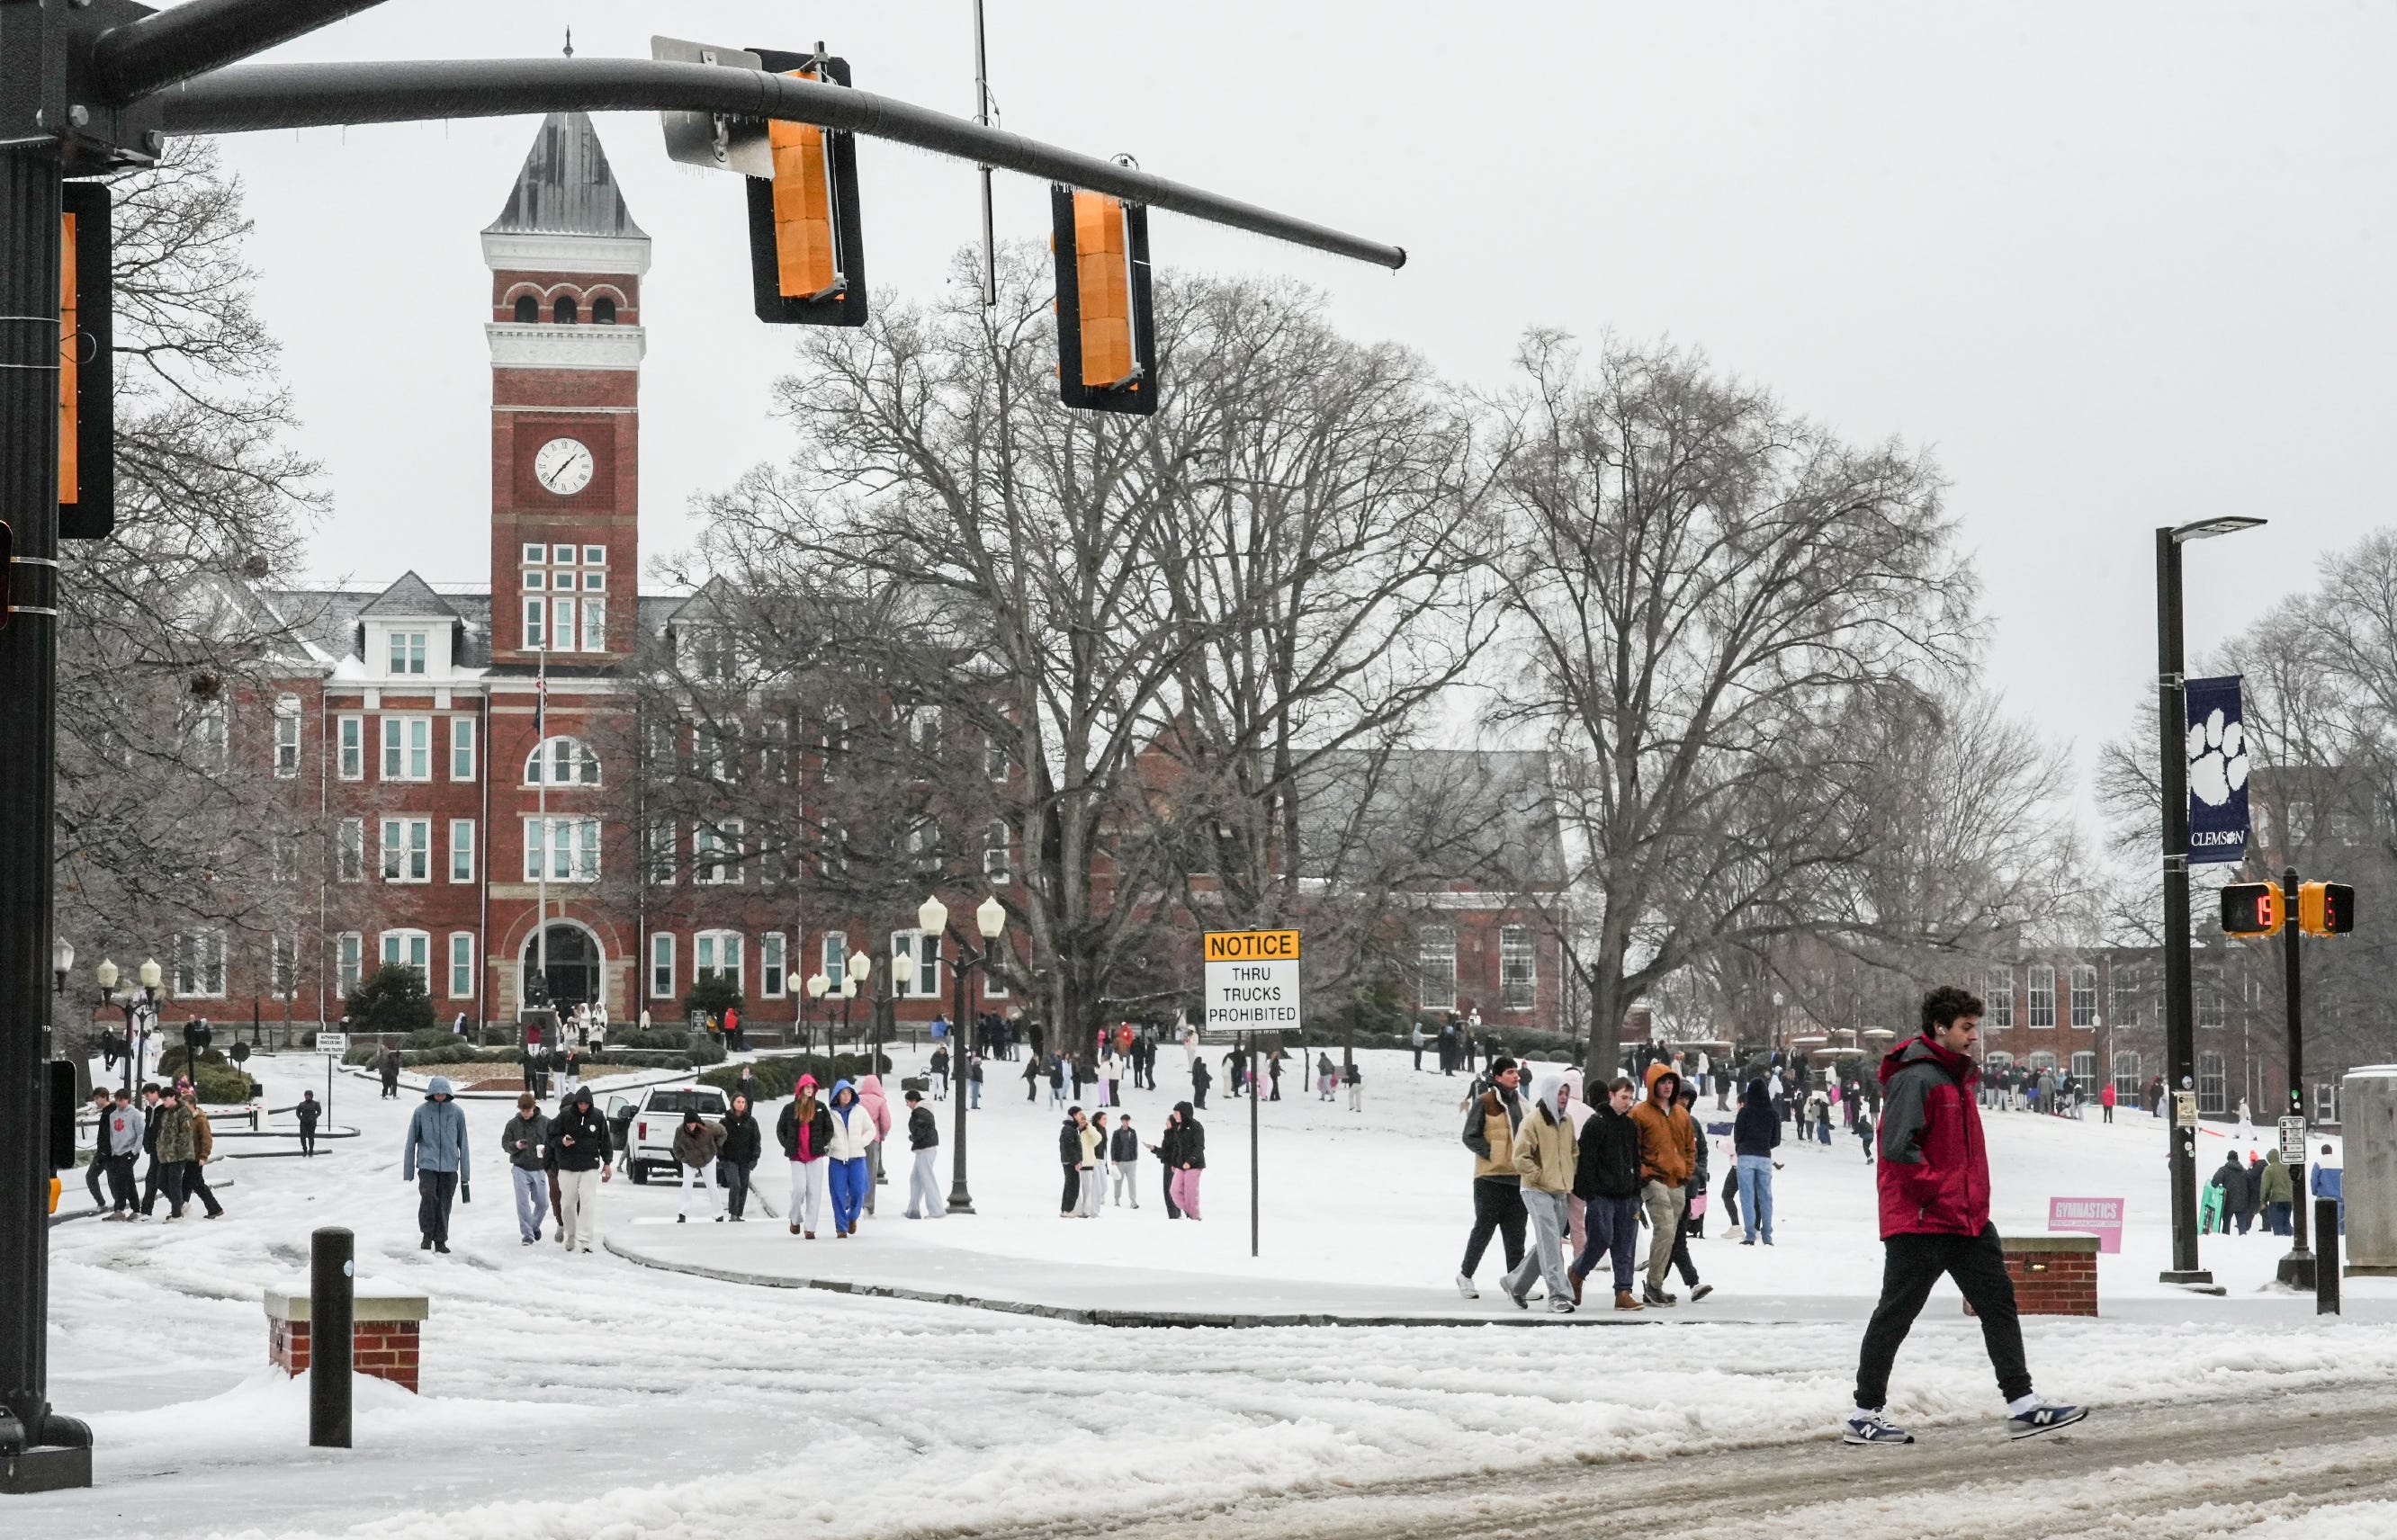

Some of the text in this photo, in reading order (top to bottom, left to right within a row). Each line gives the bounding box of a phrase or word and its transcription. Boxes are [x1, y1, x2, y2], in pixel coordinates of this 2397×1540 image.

[1211, 936, 1291, 955] NOTICE
[1232, 967, 1270, 980] THRU
[1223, 987, 1280, 1001] TRUCKS
[1209, 1007, 1296, 1022] PROHIBITED
[2056, 1202, 2117, 1219] GYMNASTICS
